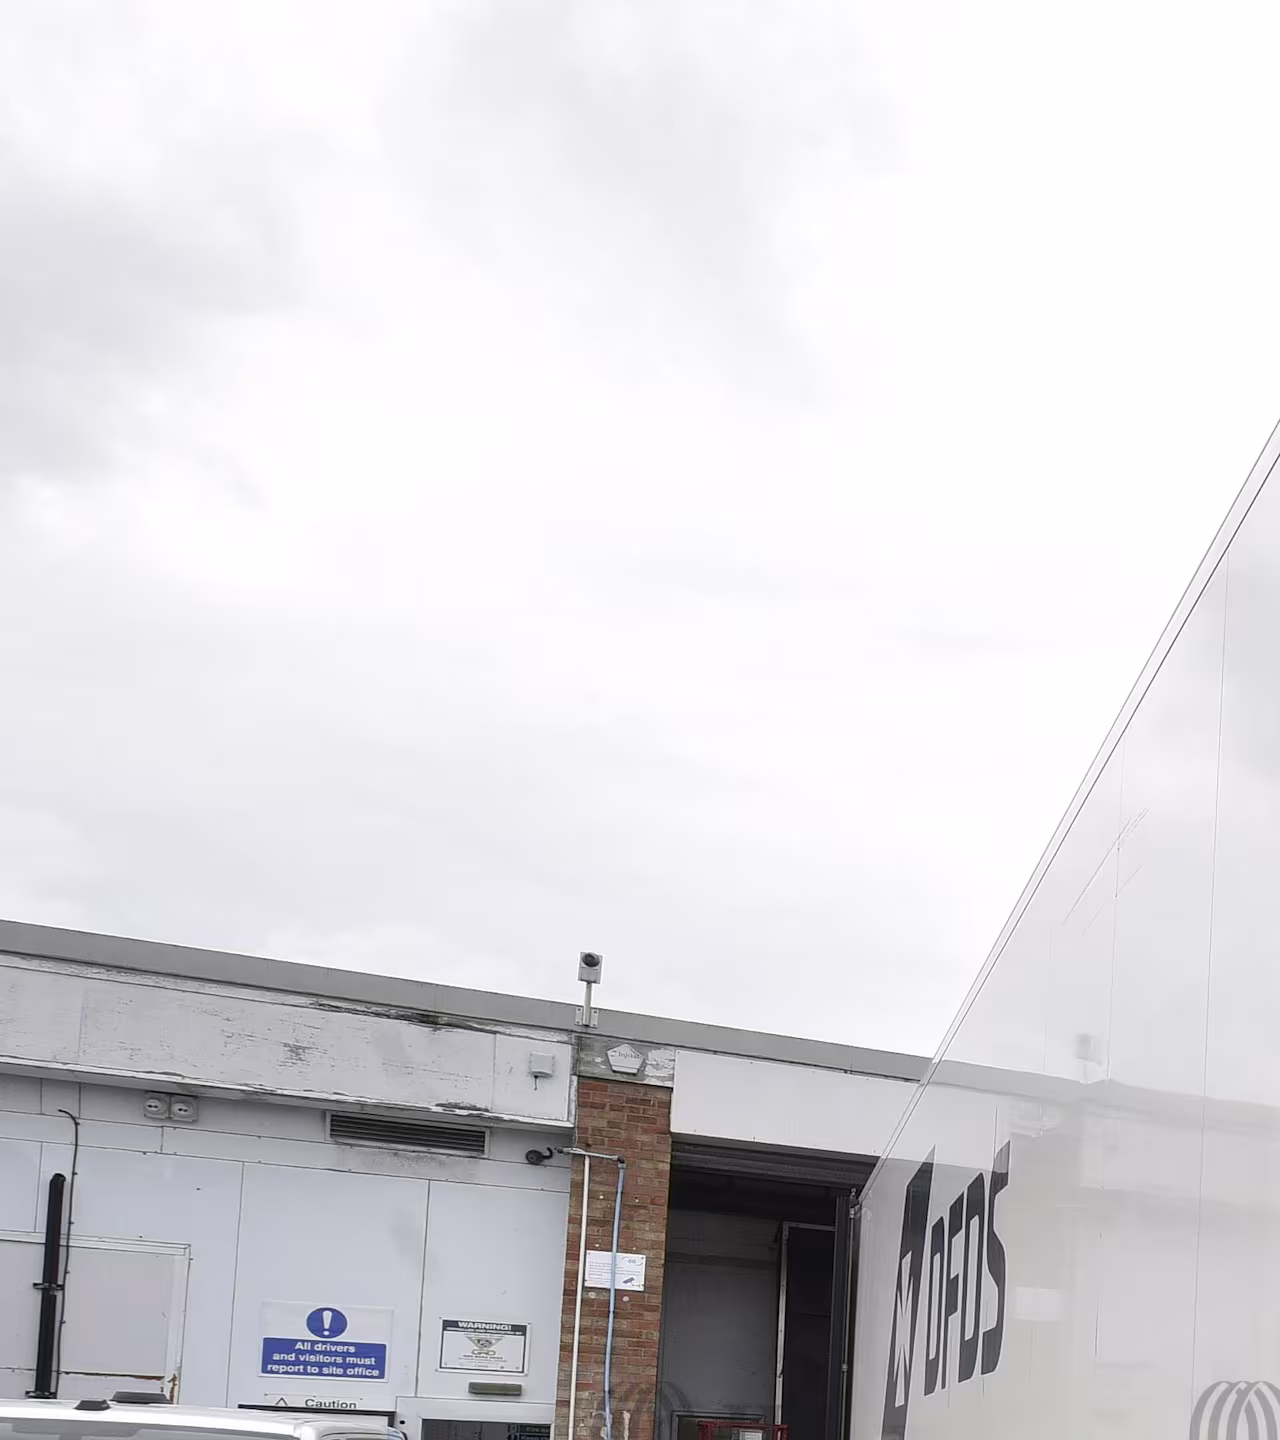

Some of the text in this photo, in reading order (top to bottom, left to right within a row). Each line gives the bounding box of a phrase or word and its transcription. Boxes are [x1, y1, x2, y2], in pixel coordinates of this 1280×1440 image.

[924, 1139, 1011, 1397] DFDS
[458, 1321, 512, 1331] WARNING!
[294, 1341, 356, 1353] All drivers
[272, 1353, 376, 1366] and visitors must
[267, 1362, 380, 1377] report to site office
[304, 1398, 357, 1410] Caution
